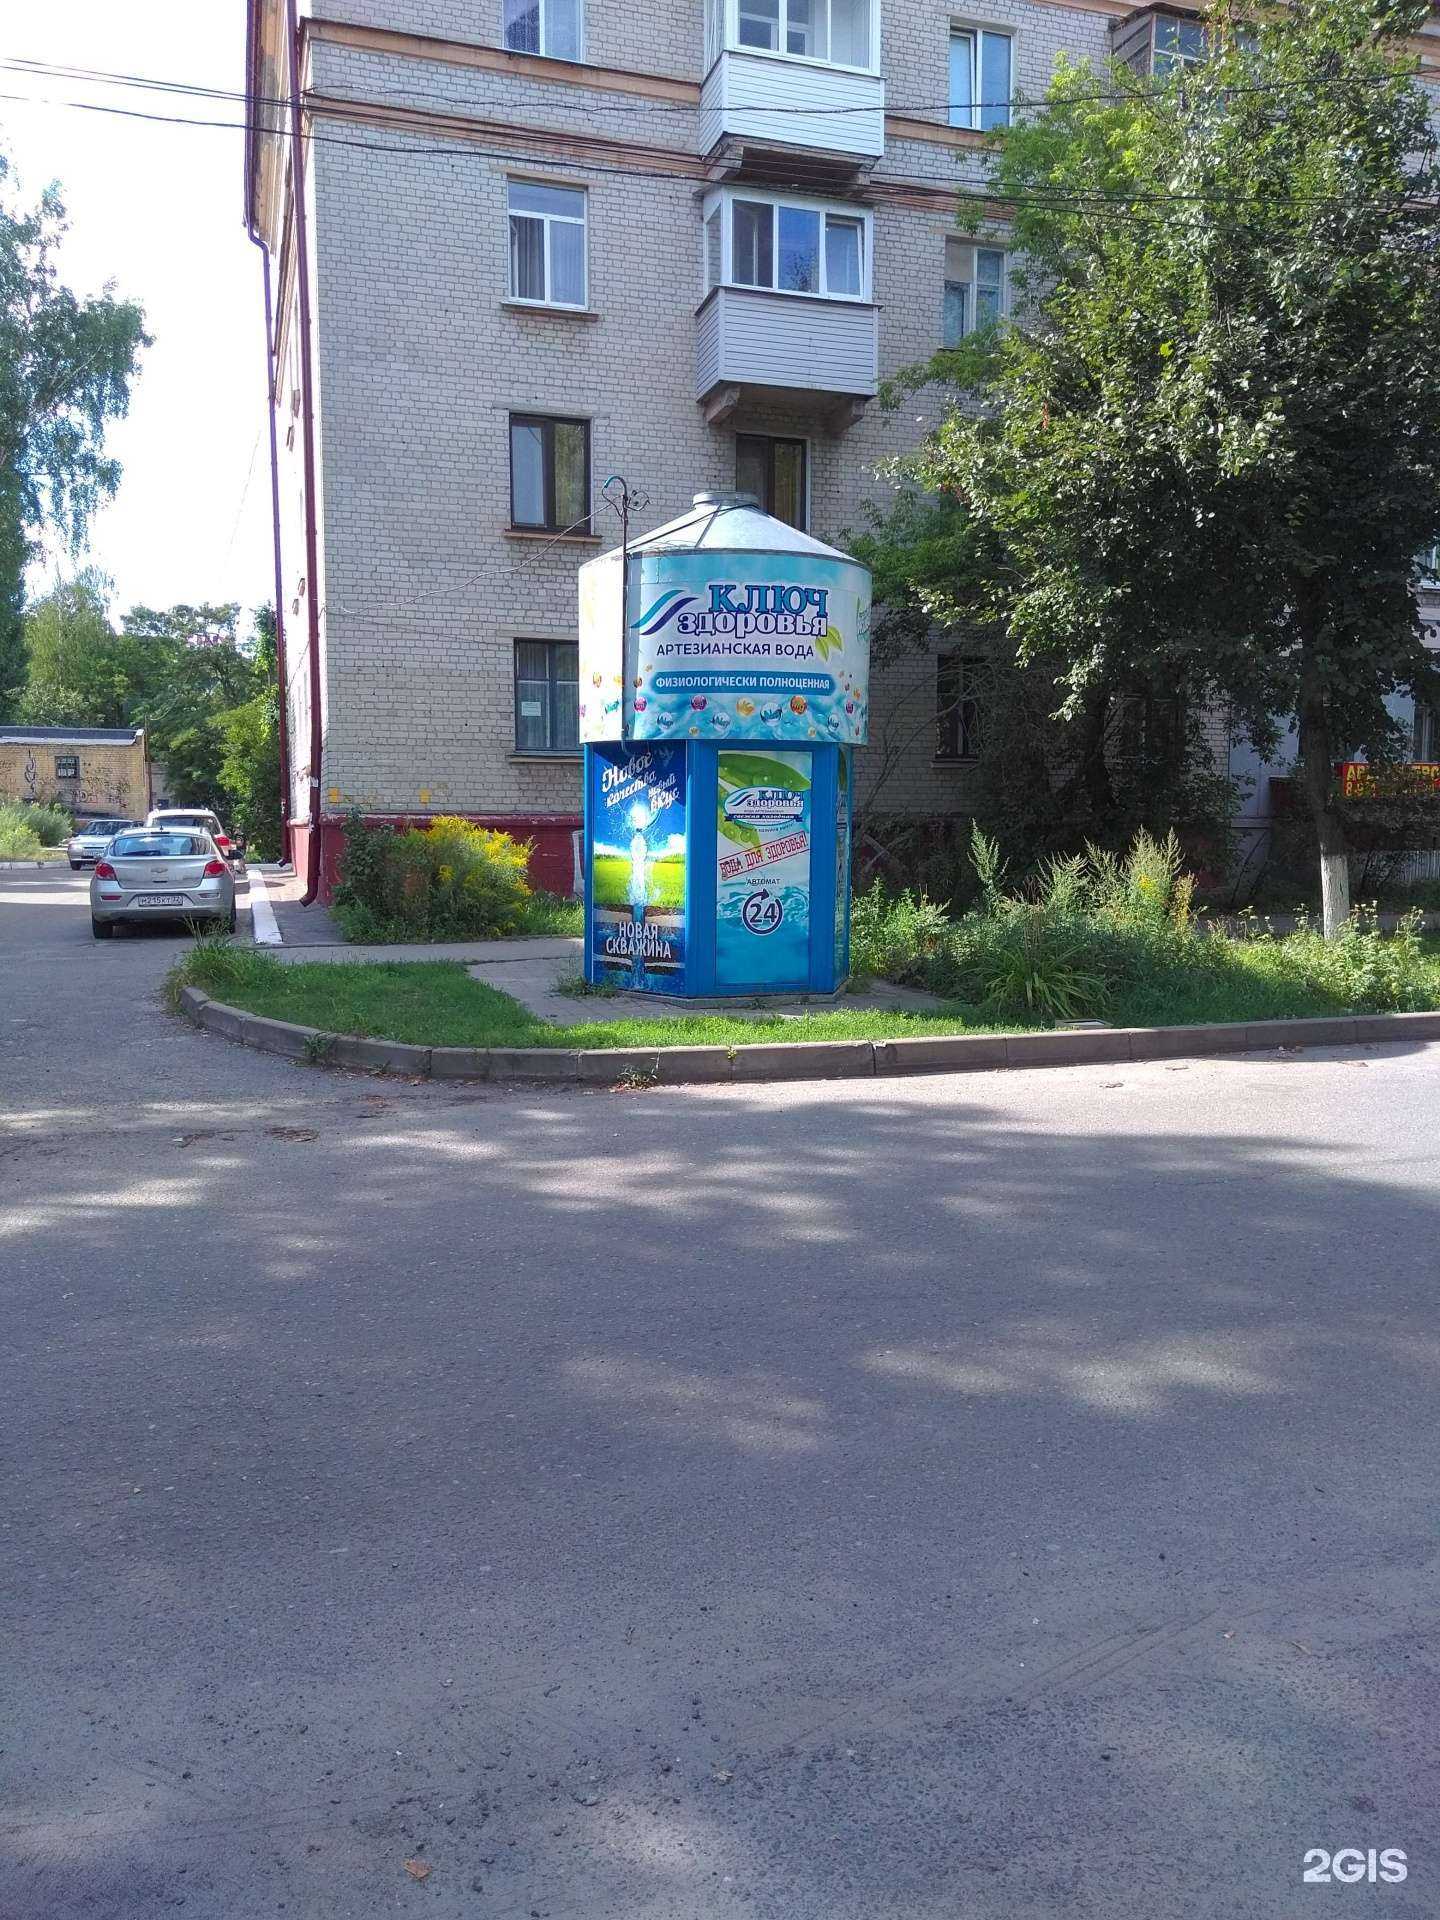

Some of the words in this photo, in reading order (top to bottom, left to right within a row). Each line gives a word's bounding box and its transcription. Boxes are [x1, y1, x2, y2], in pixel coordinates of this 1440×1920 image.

[708, 584, 829, 617] КЛЮЧ
[677, 612, 828, 638] здоровья
[656, 642, 770, 656] АРТЕЗИАНСКАЯ
[775, 644, 814, 659] ВОДА
[656, 674, 757, 689] ФИЗИОЛОГИЧЕСКИ
[759, 676, 830, 690] ПОЛНОЦЕННАЯ
[601, 752, 654, 793] Новое
[758, 790, 804, 802] КЛЮЧ
[719, 857, 743, 876] ВОДА
[745, 849, 763, 867] ДЛЯ
[765, 834, 809, 860] ЗДОРОВЬЯ!
[749, 902, 778, 924] 24
[619, 921, 658, 940] НОВАЯ
[606, 936, 672, 959] СКВАЖИНА
